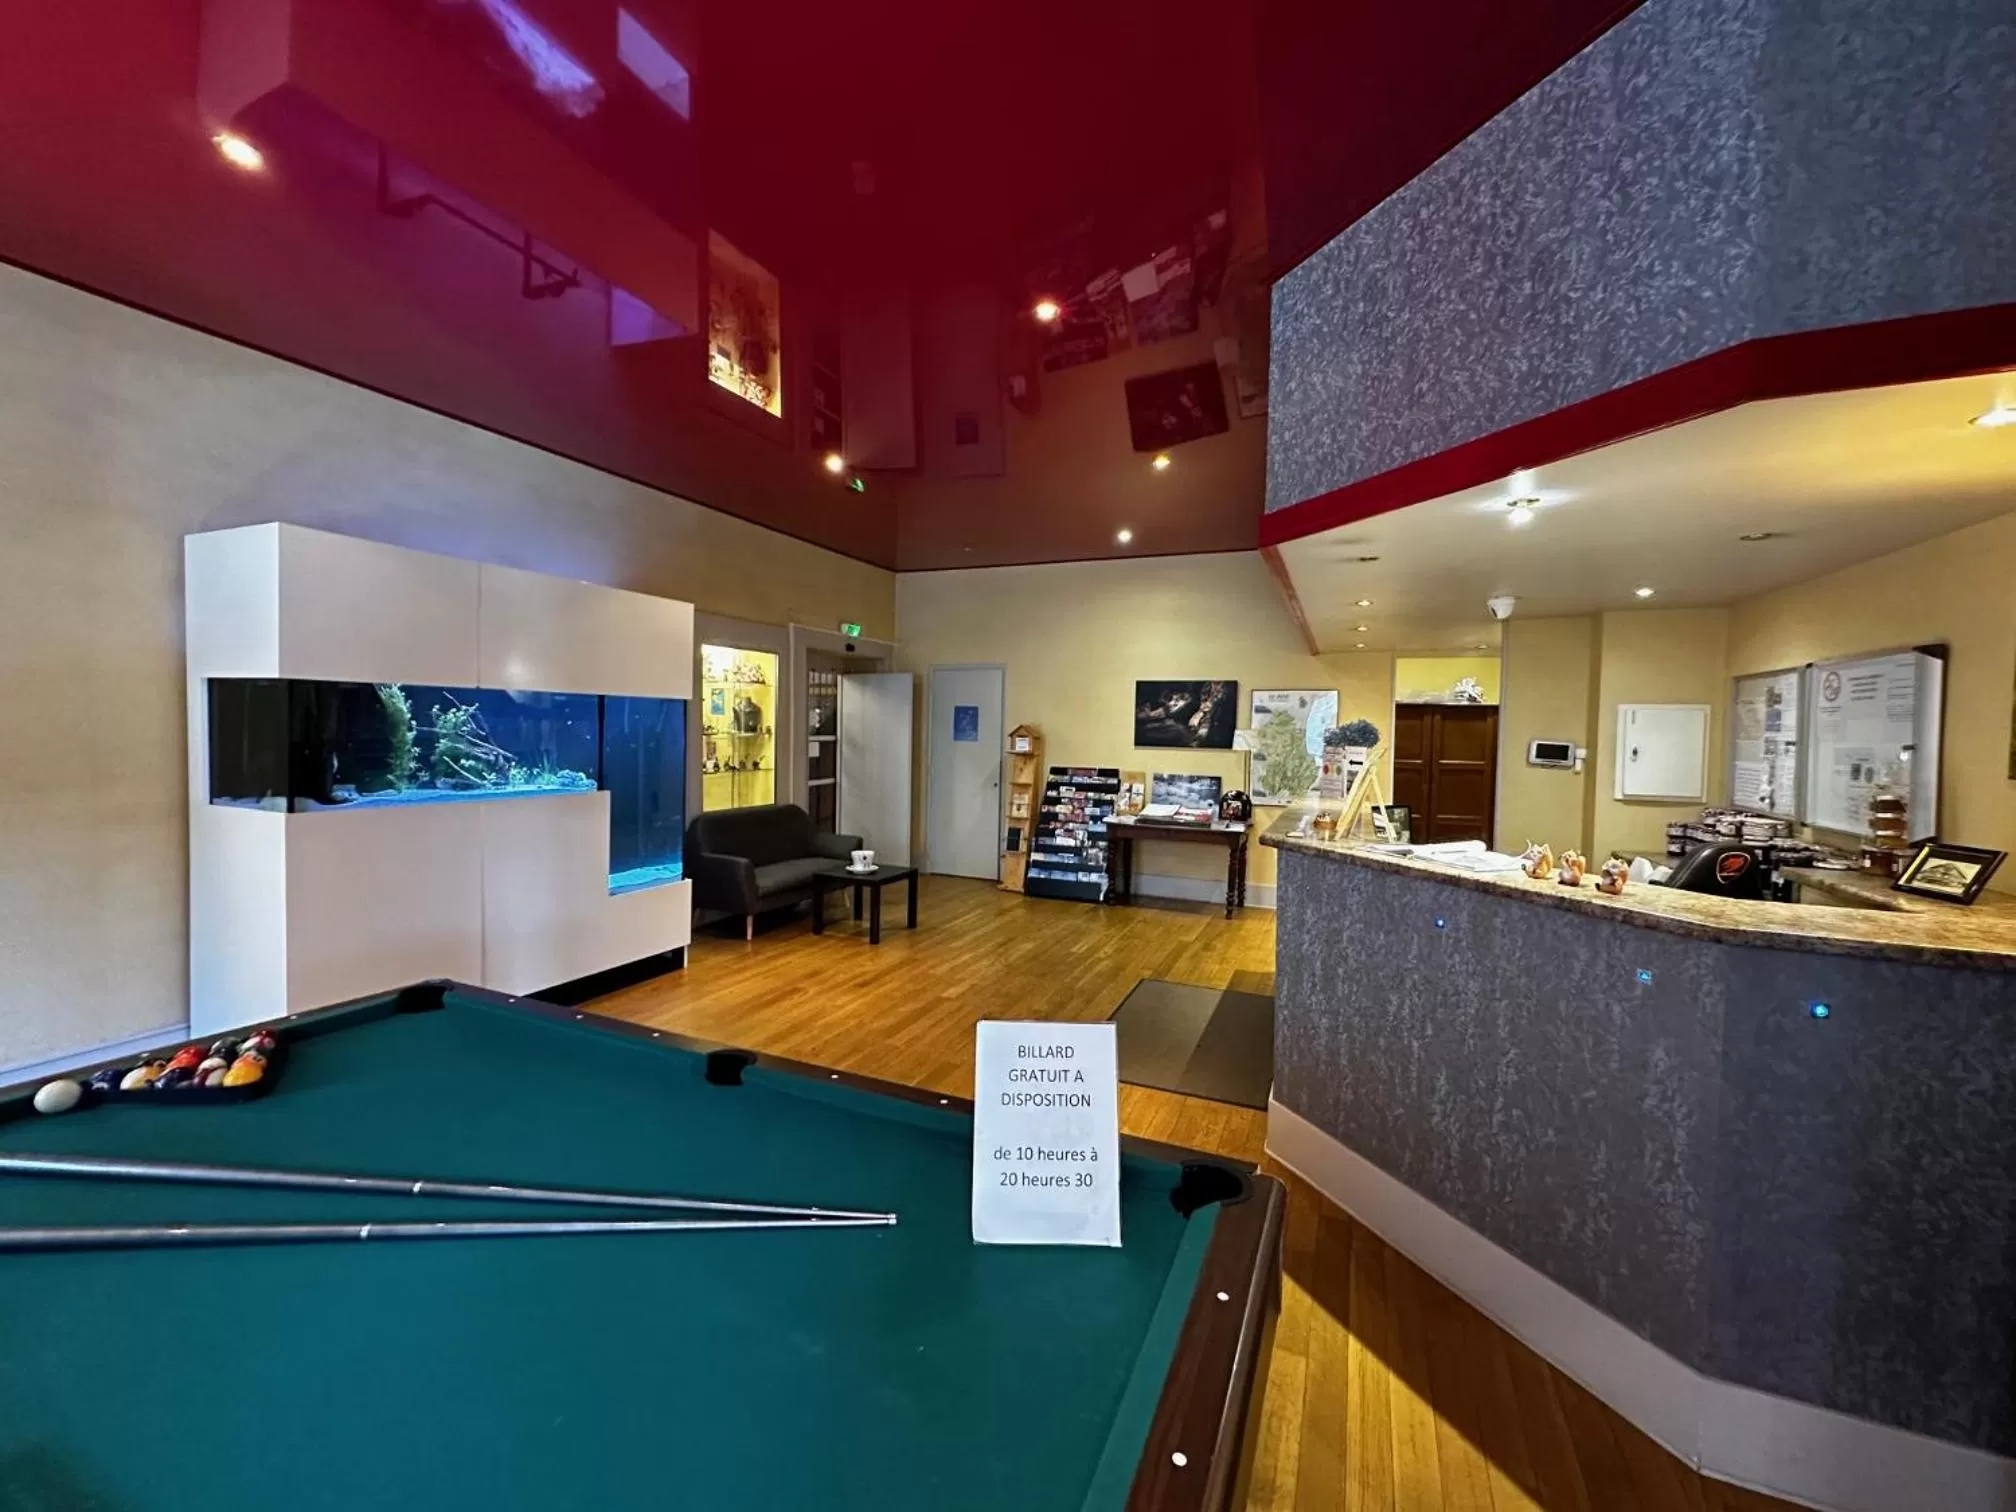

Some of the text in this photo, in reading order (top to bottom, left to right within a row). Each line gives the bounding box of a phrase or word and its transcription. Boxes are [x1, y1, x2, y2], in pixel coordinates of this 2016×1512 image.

[1018, 1045, 1075, 1059] BILLARD
[1008, 1068, 1084, 1083] GRATUIT A
[1001, 1092, 1091, 1107] DISPOSITION
[993, 1146, 1098, 1162] de 10 heures à
[1000, 1172, 1093, 1188] 20 heures 30
